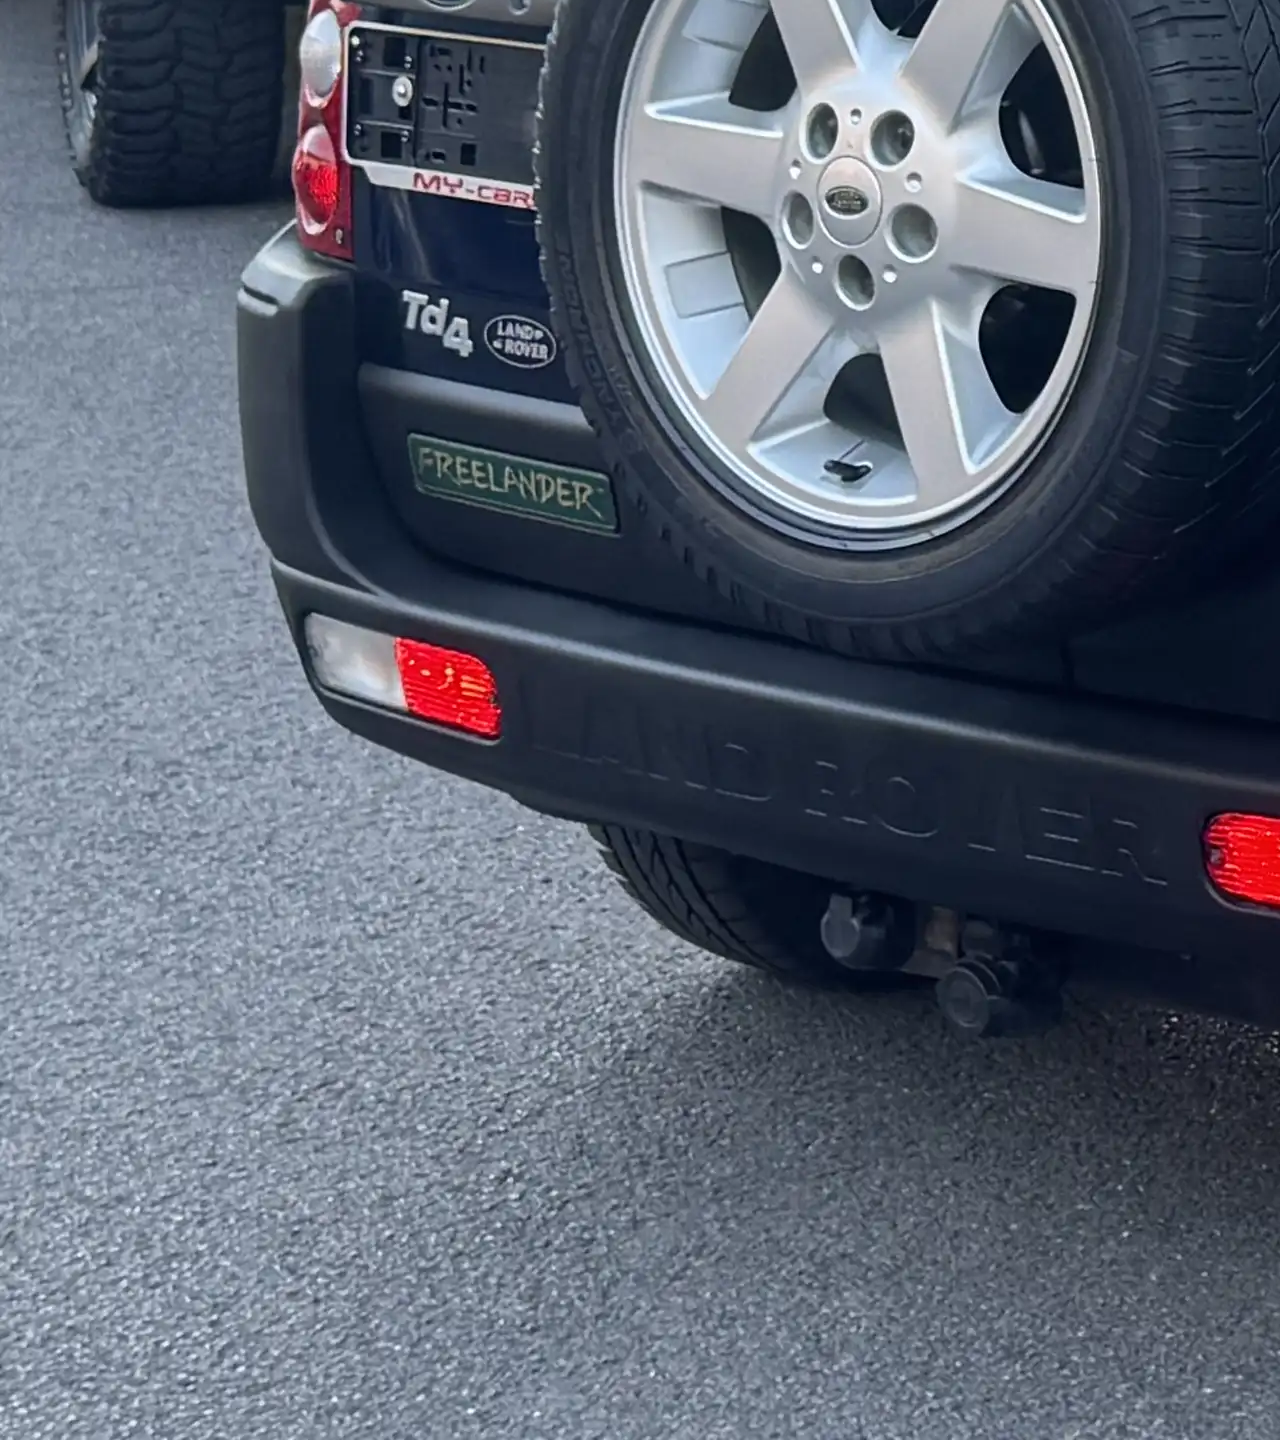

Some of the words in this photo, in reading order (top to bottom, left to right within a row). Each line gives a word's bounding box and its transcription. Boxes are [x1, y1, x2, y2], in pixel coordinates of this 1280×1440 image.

[402, 289, 473, 357] Td4
[497, 320, 535, 340] LAND
[504, 339, 549, 360] ROVER
[419, 447, 604, 520] FREELANDER
